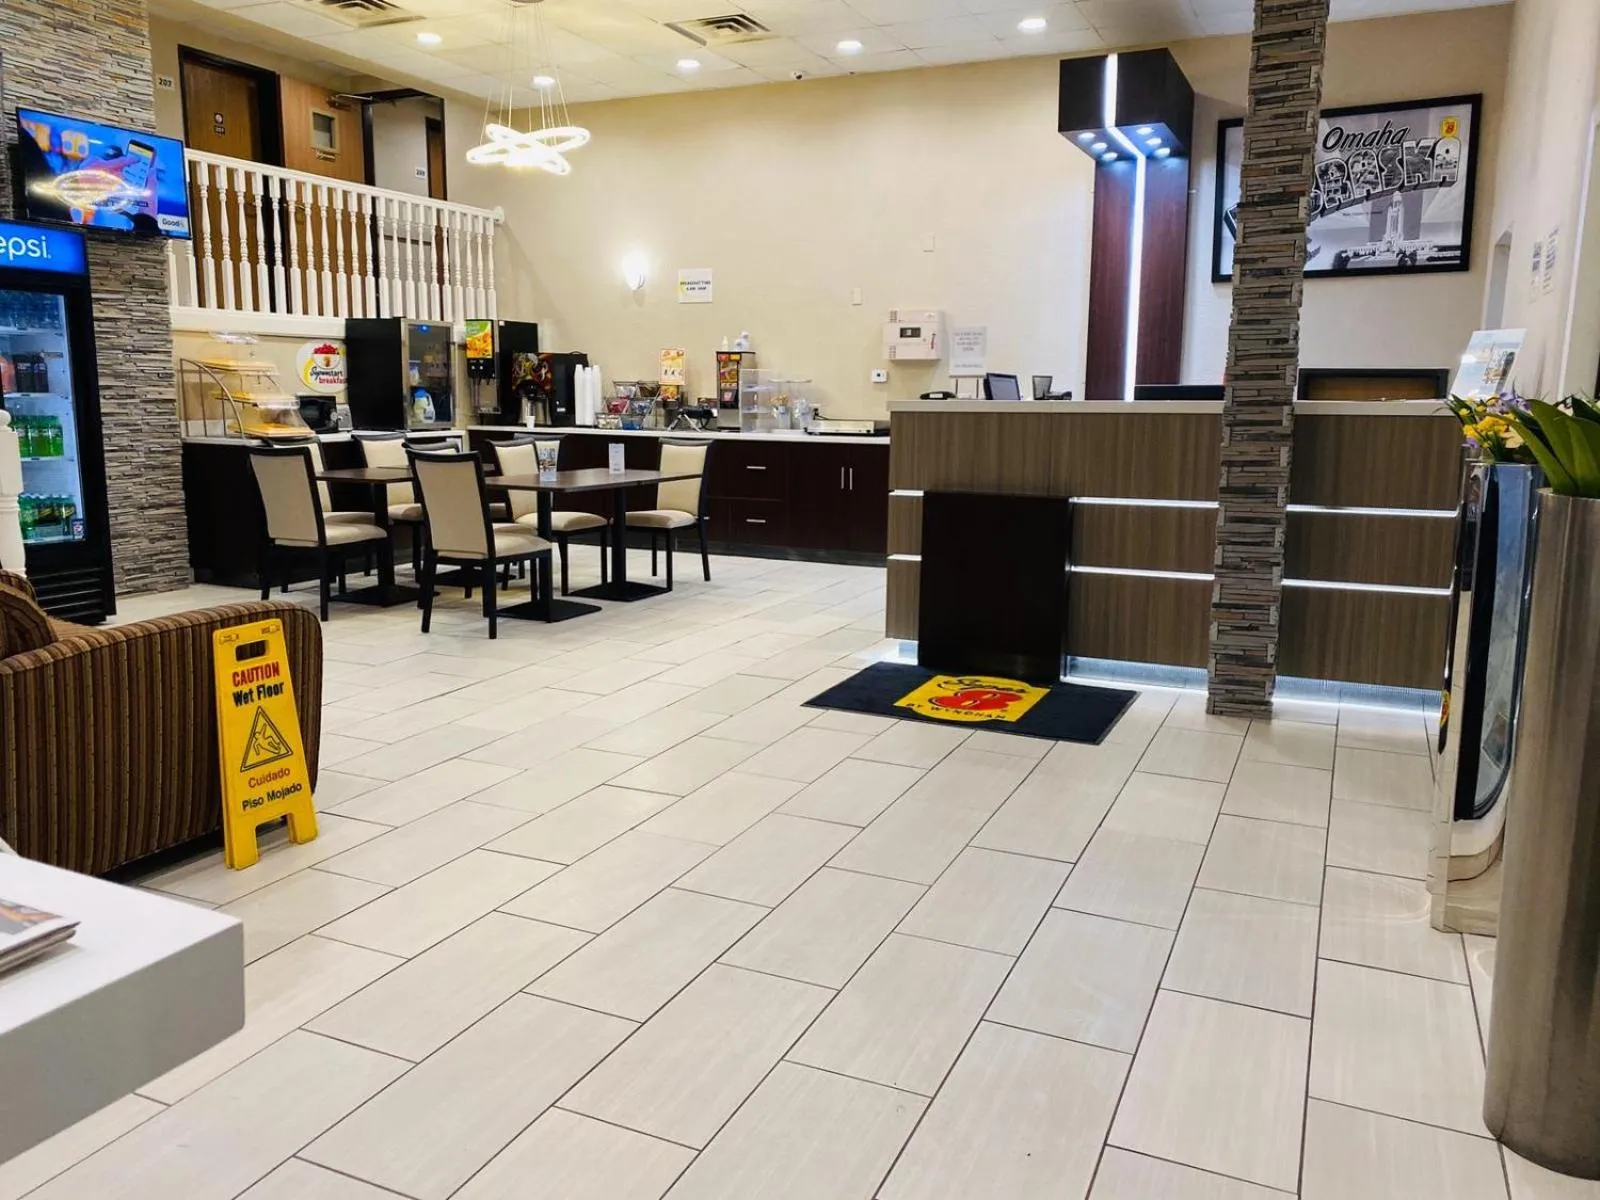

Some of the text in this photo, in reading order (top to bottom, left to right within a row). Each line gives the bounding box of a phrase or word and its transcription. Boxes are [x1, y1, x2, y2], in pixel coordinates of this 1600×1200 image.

[1322, 120, 1410, 152] Omaha
[232, 661, 280, 687] CAUTION
[232, 682, 285, 707] Wet Floor
[248, 767, 291, 788] Cuidado
[242, 783, 303, 811] Piso Mojado
